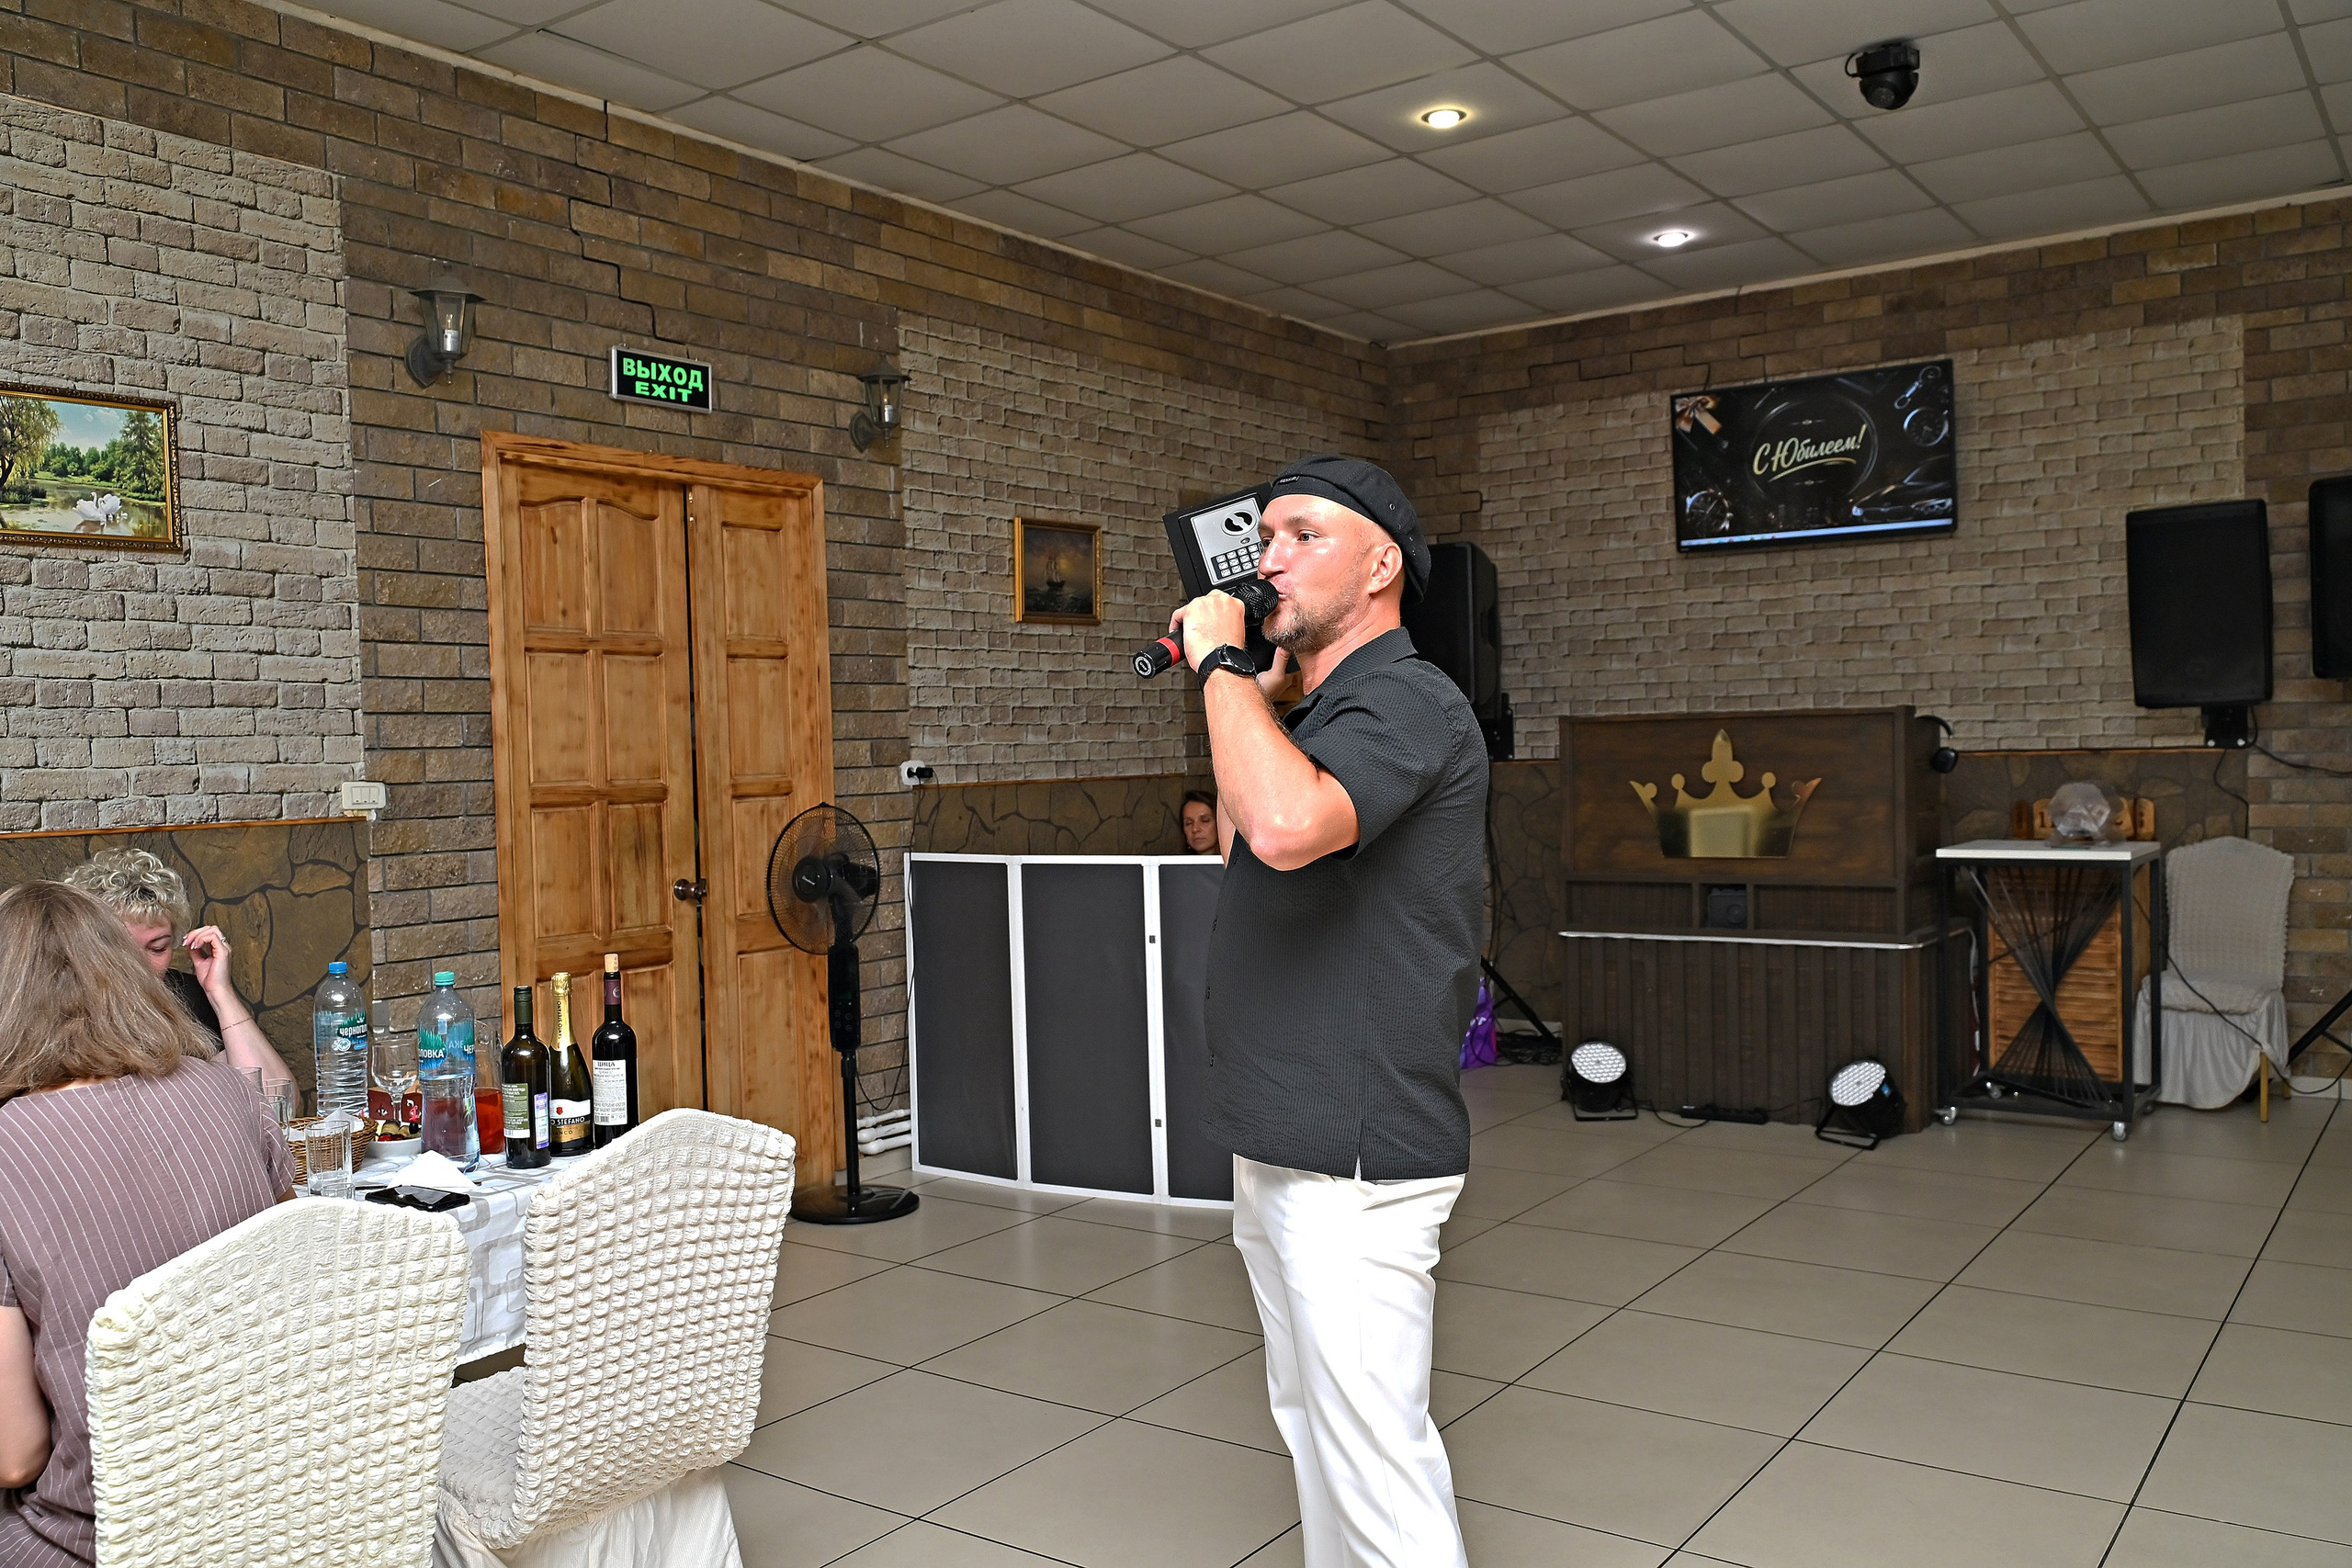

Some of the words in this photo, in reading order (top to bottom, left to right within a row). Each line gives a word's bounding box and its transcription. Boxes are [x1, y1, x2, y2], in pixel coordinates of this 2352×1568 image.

[623, 357, 703, 392] ВЫХОД
[635, 380, 693, 402] EXIT
[1753, 443, 1770, 475] С
[1771, 423, 1867, 472] Юбилеем!
[557, 1116, 585, 1125] STEFANO
